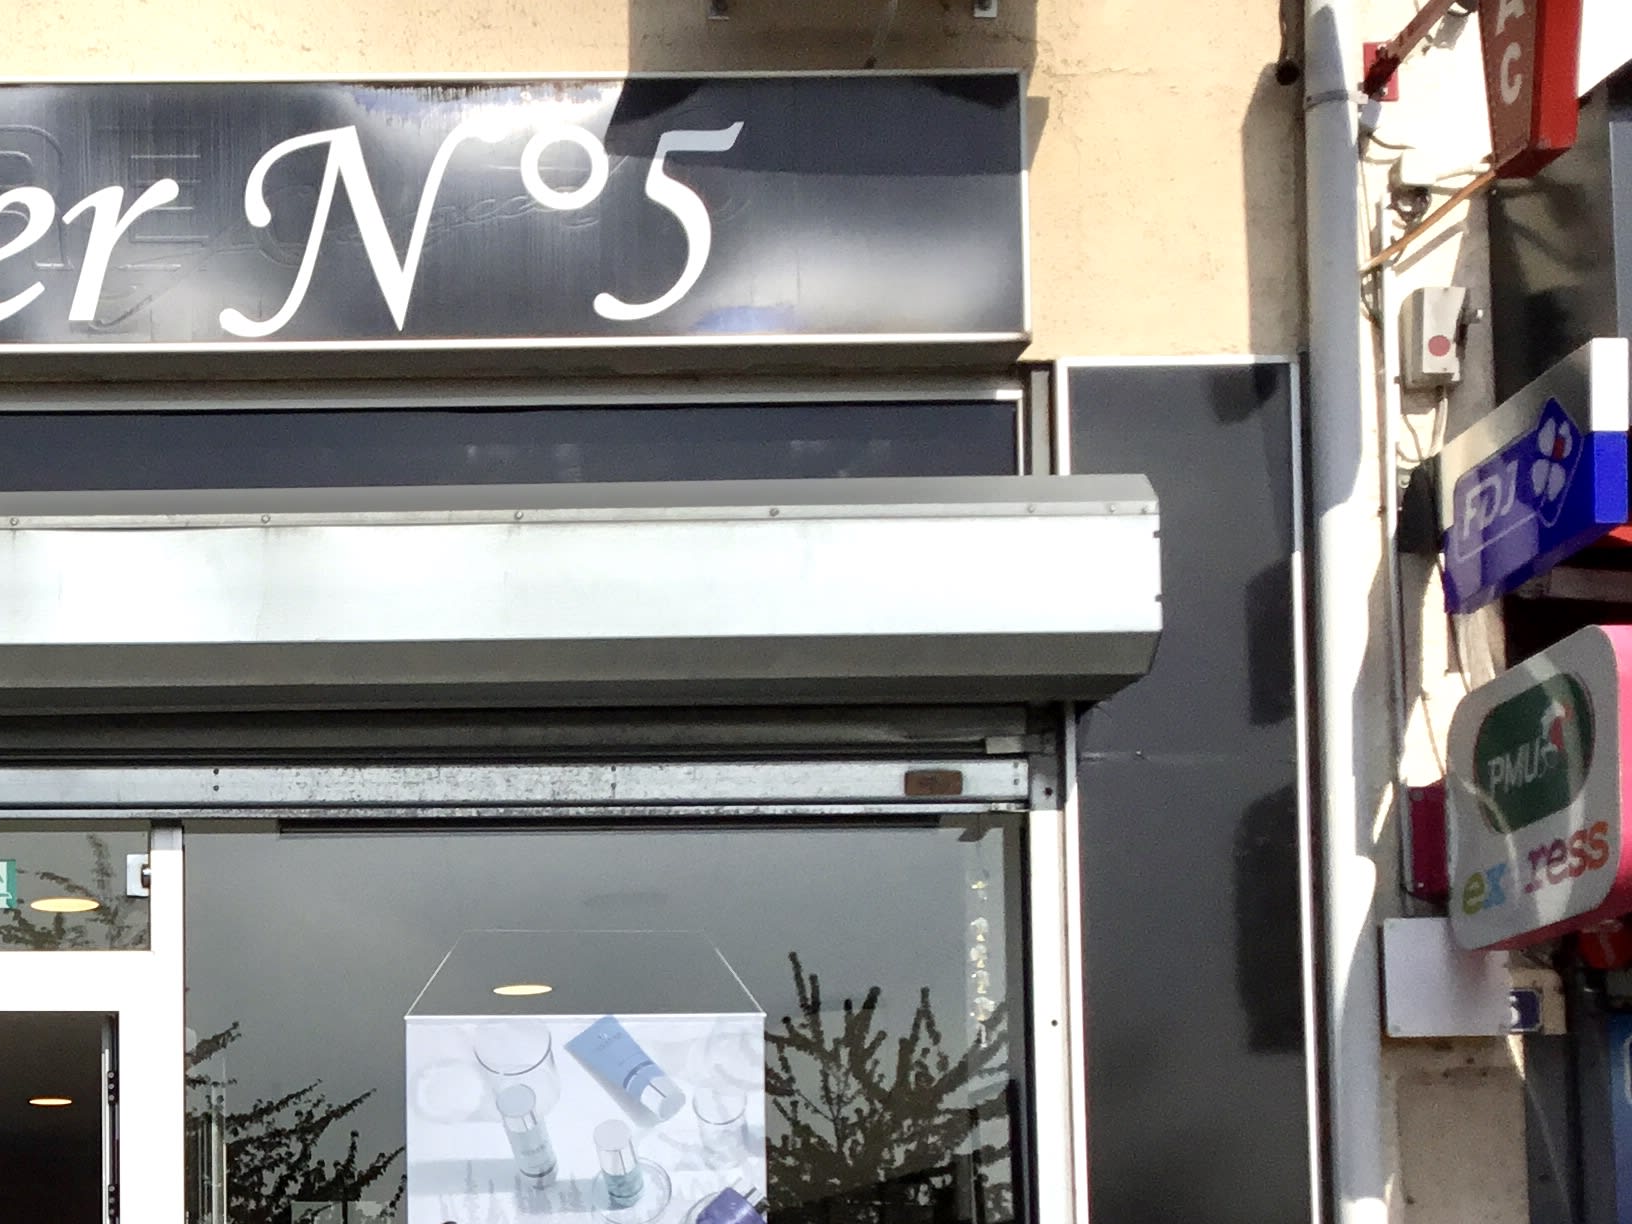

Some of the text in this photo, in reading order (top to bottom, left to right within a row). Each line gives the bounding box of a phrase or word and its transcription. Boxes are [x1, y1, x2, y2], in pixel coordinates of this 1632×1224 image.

[220, 121, 745, 337] N°5
[1463, 459, 1518, 540] FDJ
[1488, 738, 1540, 799] PMU
